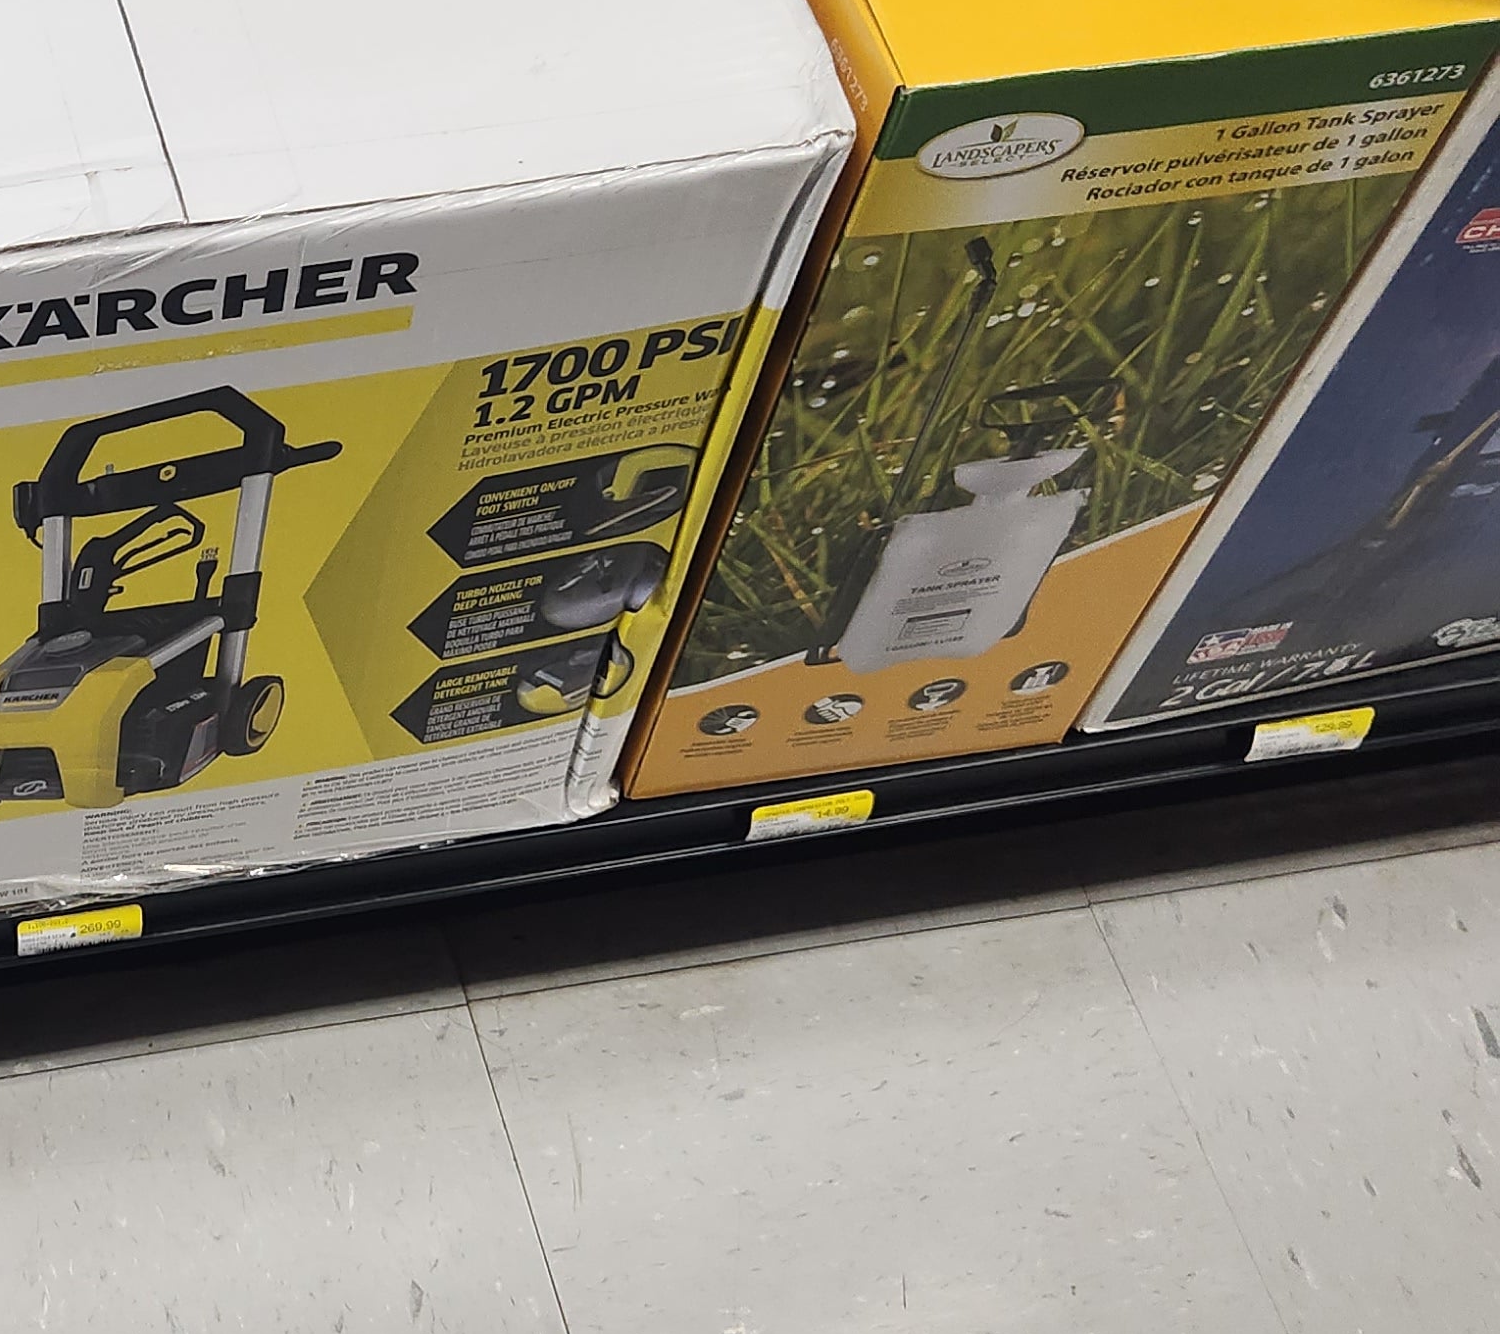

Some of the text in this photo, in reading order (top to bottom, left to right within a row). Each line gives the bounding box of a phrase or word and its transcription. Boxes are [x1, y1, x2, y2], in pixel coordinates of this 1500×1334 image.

[1369, 63, 1466, 90] 6361273
[1215, 100, 1445, 141] 1 Gallon Tank Sprayer
[931, 137, 1063, 170] LANDSCAPERS
[1061, 125, 1429, 183] Réservoir pulvérisateur de 1 gallon
[1086, 147, 1414, 203] Rociador con tanque de 1 galon
[478, 314, 745, 399] 1700 PSI
[464, 393, 690, 446] Premium Electric Pressure
[472, 374, 642, 429] 1.2 GPM
[457, 426, 657, 472] Hidrolavadora eléctrica a
[460, 435, 531, 459] Laveuse
[536, 433, 546, 445] à
[550, 420, 622, 445] pression
[475, 496, 539, 516] FOOT SWITCH
[479, 477, 578, 505] CONVENIENT ON/OFF
[453, 589, 523, 612] DEEP CLEANING
[455, 575, 543, 601] TURBO NOZZLE FOR
[436, 665, 518, 690] LARGE REMOVABLE
[1173, 642, 1364, 684] LIFETIME WARRANTY
[433, 677, 509, 700] DETERGENT TANK
[1159, 686, 1194, 707] 2
